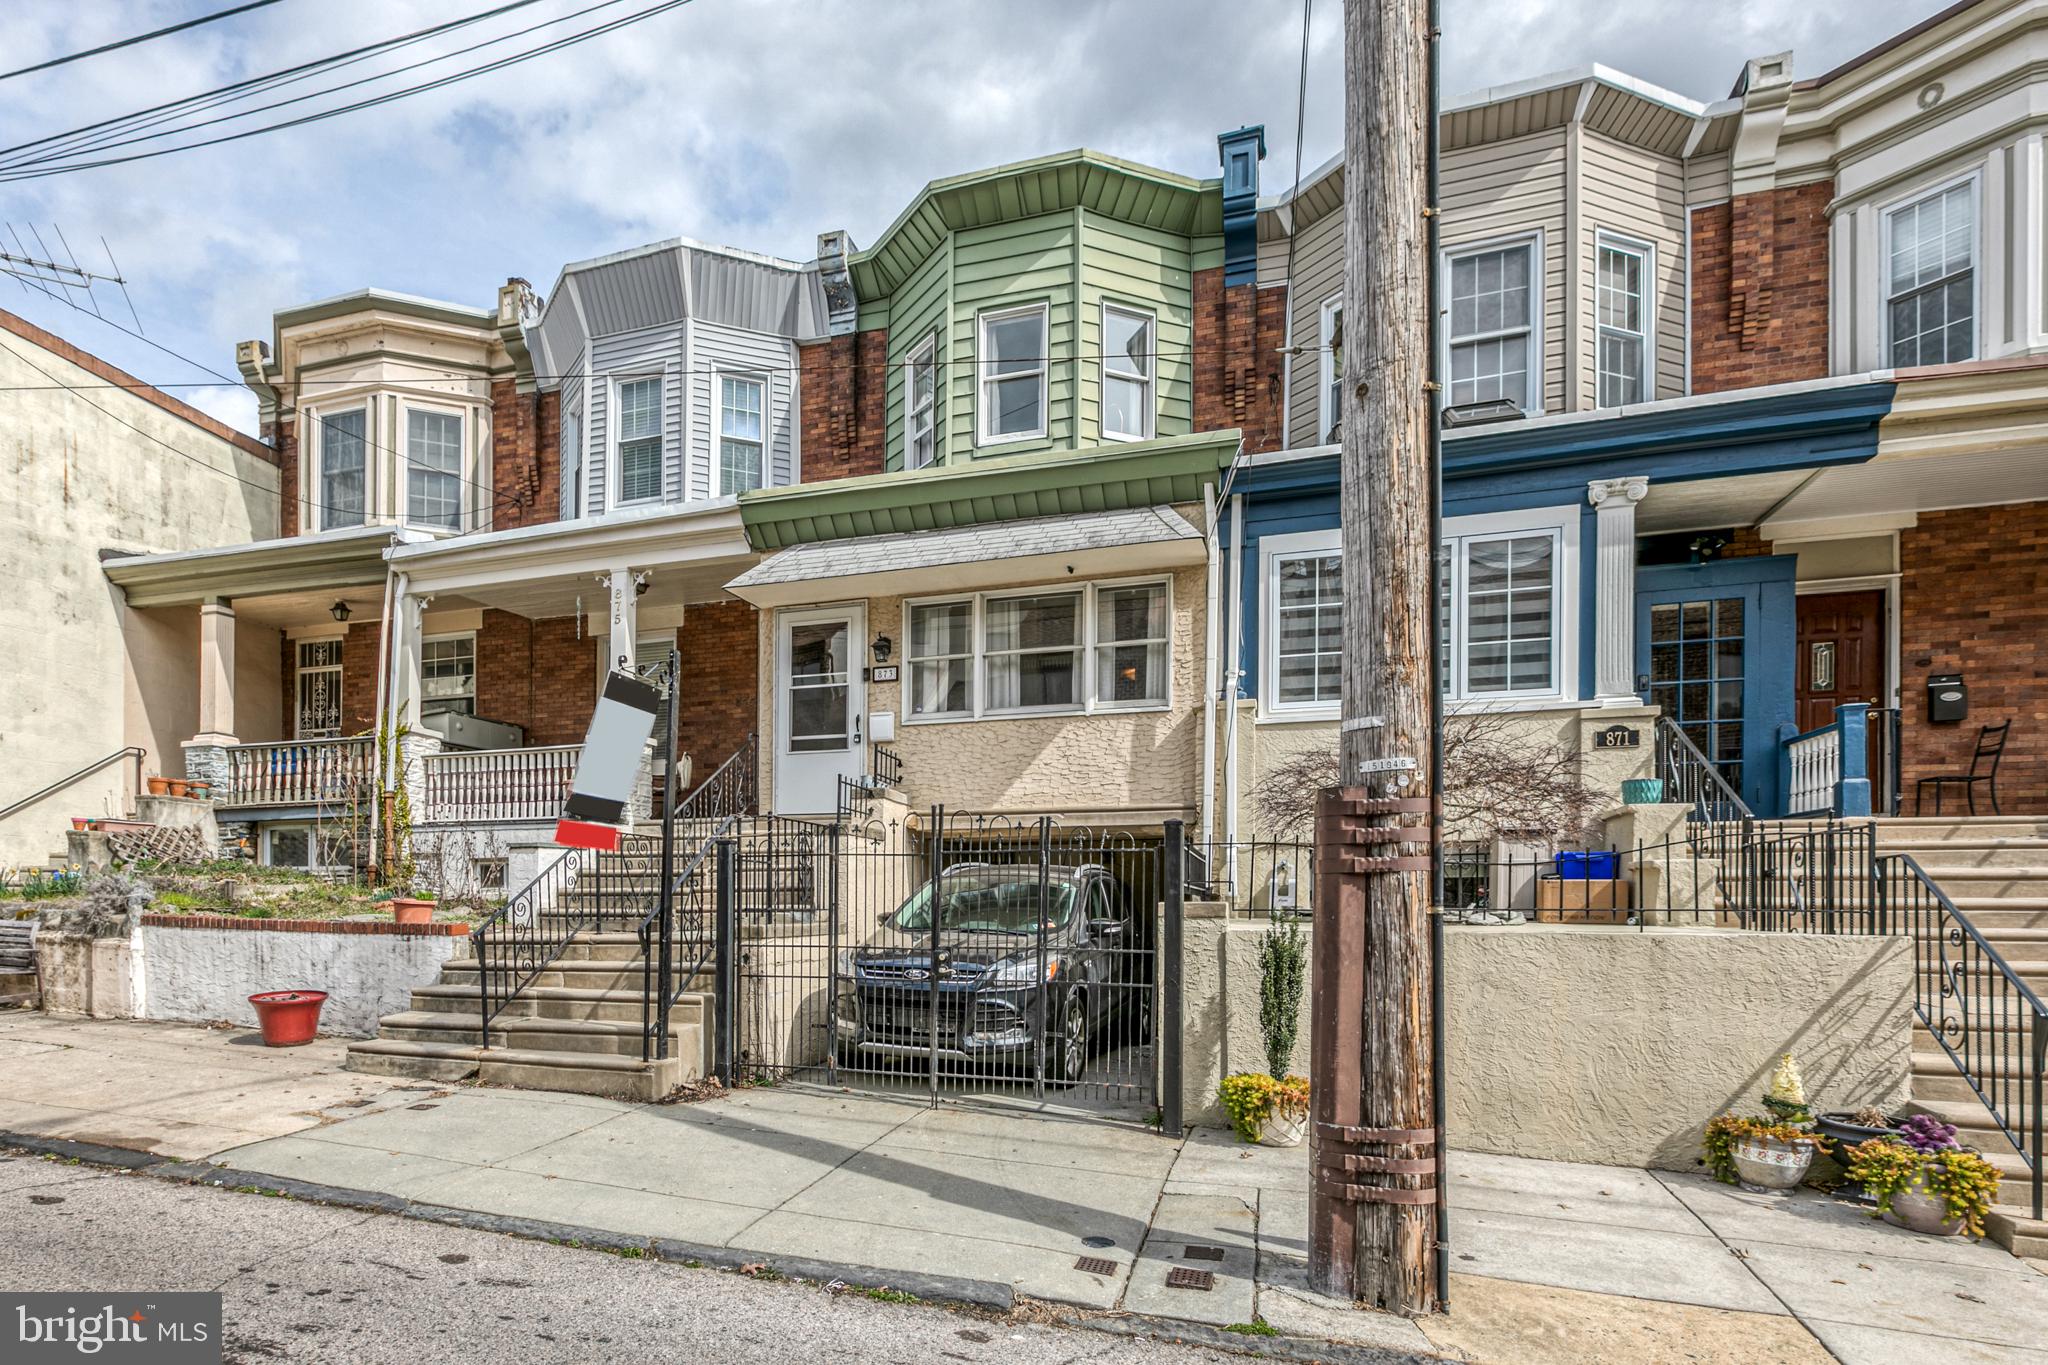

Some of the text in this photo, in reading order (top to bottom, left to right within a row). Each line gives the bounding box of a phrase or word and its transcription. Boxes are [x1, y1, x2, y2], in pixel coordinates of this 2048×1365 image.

[614, 588, 622, 625] 875
[877, 669, 893, 679] 873
[1606, 731, 1630, 746] 871
